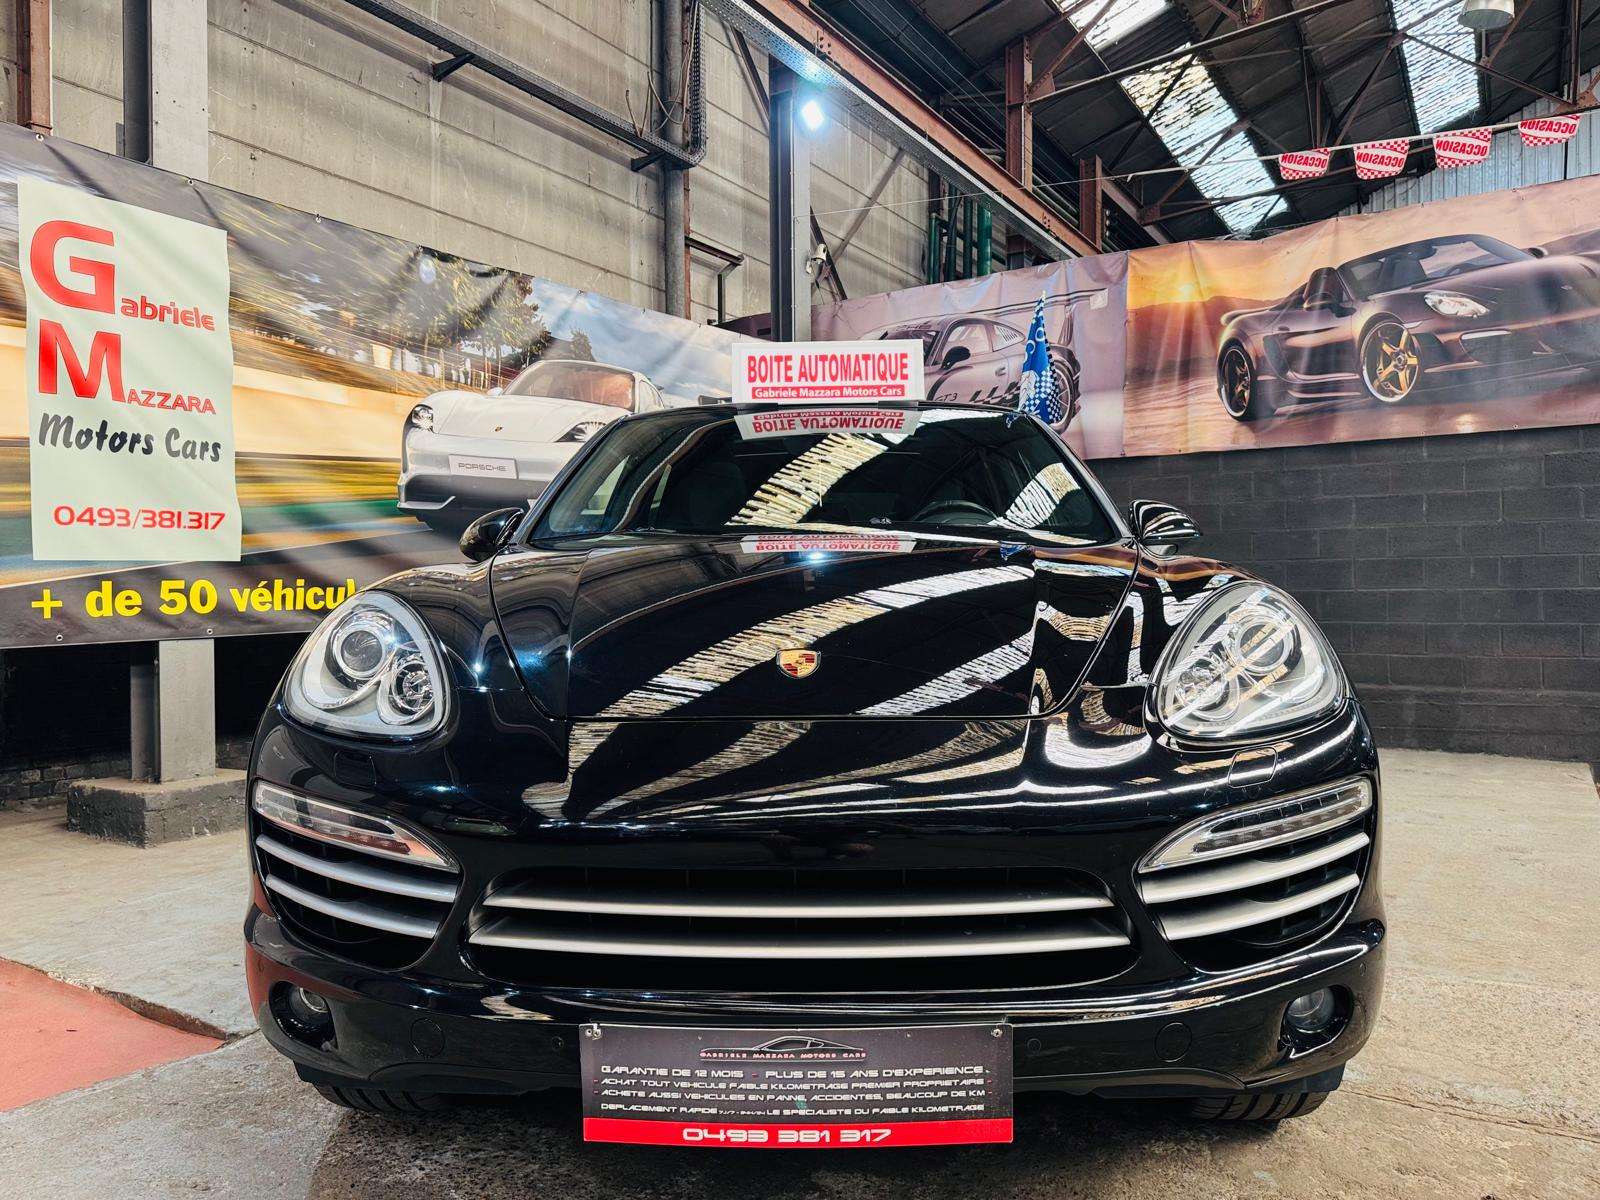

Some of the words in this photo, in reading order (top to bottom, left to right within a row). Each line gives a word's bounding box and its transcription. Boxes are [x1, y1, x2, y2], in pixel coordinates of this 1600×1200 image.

[747, 354, 794, 384] BOITE
[798, 352, 909, 382] AUTOMATIQUE
[754, 387, 798, 398] Gabriele
[799, 387, 841, 397] Mazzara
[842, 386, 878, 397] Motors
[880, 385, 902, 396] Cars
[38, 412, 155, 455] Motors
[165, 427, 222, 463] Cars
[458, 462, 508, 472] PORSCHE
[53, 505, 226, 530] 0493/381.317
[85, 580, 143, 617] de
[158, 579, 218, 615] 50
[601, 1065, 669, 1076] GARANTIE
[672, 1068, 692, 1077] DE
[694, 1069, 708, 1077] 12
[711, 1070, 744, 1078] MOIS
[765, 1070, 804, 1079] PLUS
[807, 1070, 827, 1079] DE
[830, 1070, 846, 1078] 15
[849, 1069, 879, 1078] ANS
[882, 1066, 984, 1077] D'EXPERIENCE
[601, 1078, 638, 1086] ACHAT
[673, 1081, 727, 1089] VEHICULE
[729, 1082, 768, 1090] FAIBLE
[851, 1081, 901, 1089] PREMIER
[903, 1078, 985, 1088] PROPRIETAIRE
[601, 1089, 646, 1098] ACHETE
[648, 1091, 682, 1099] AUSSI
[684, 1093, 746, 1101] VEHICULES
[766, 1094, 807, 1102] PANNE,
[886, 1091, 948, 1100] BEAUCOUP
[950, 1090, 967, 1098] DE
[600, 1103, 678, 1113] DEPLACEMENT
[680, 1106, 718, 1114] RAPIDE
[783, 1108, 852, 1116] SPECIALISTE
[911, 1104, 985, 1113] KILOMETRAGE
[682, 1128, 769, 1143] 0493
[777, 1129, 831, 1143] 381
[839, 1128, 892, 1143] 317
